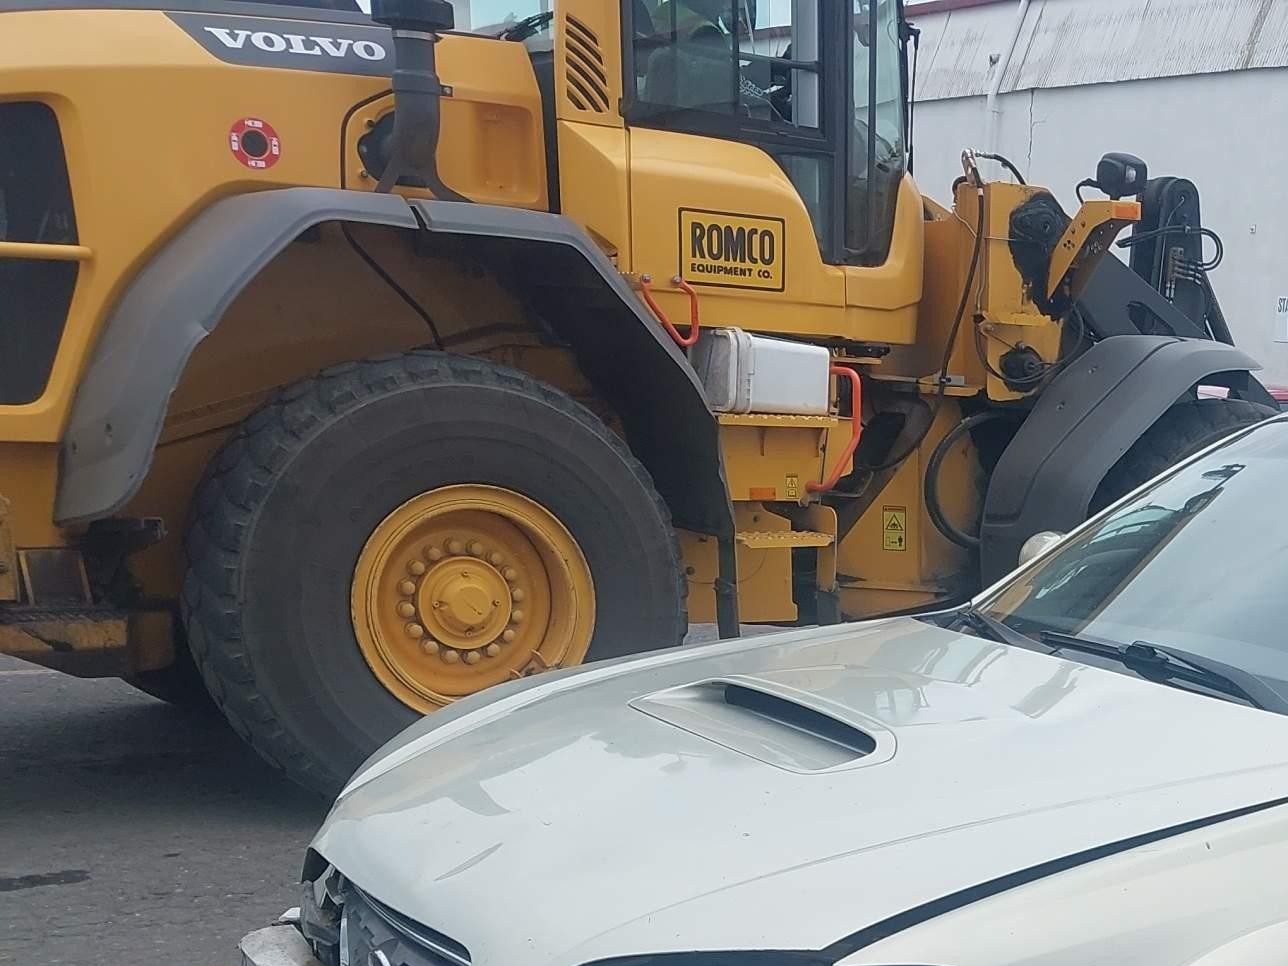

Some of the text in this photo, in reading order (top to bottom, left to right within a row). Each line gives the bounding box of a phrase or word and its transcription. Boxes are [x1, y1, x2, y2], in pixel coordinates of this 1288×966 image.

[204, 27, 386, 61] VOLVO
[691, 222, 775, 266] ROMCO
[691, 263, 773, 280] EQUIPMENT CO.
